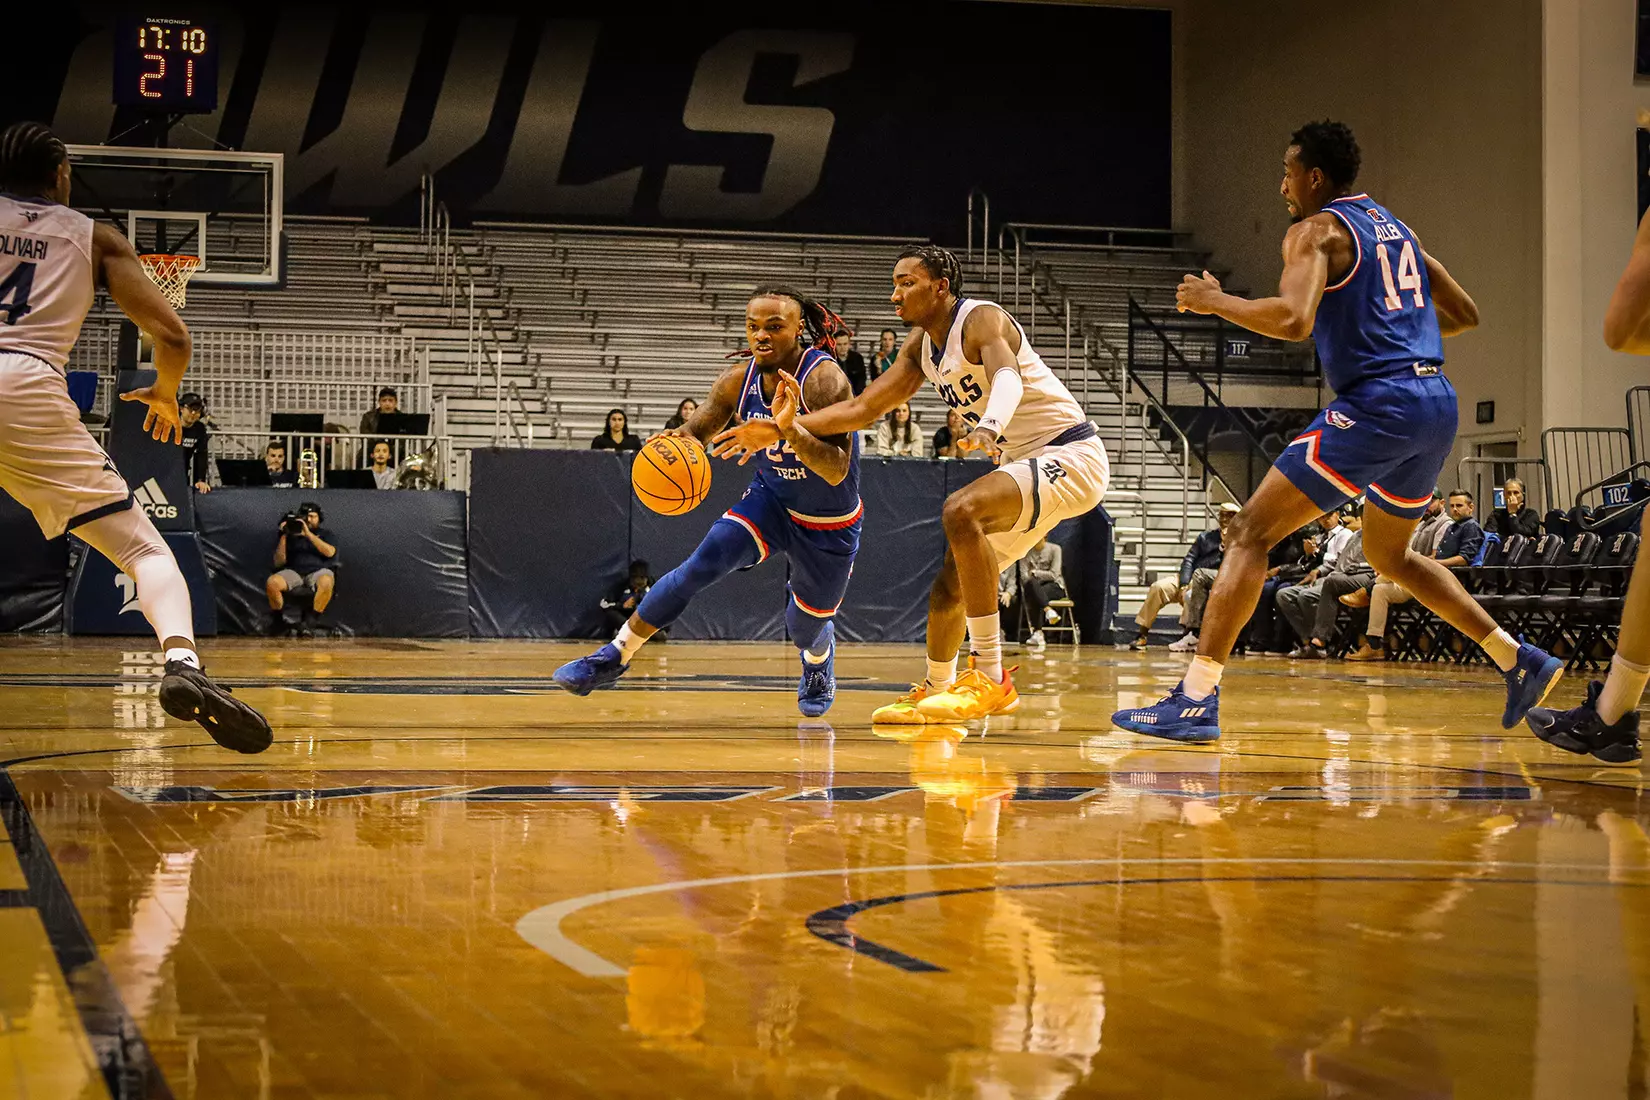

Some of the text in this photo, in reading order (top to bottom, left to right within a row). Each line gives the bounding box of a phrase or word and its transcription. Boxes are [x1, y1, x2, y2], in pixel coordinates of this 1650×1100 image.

[146, 17, 191, 25] DAKTRONICS
[139, 26, 206, 54] 17:10
[140, 54, 193, 98] 21
[1376, 240, 1425, 311] 14
[1232, 343, 1247, 355] 117
[772, 465, 808, 480] TECH
[1607, 486, 1630, 504] 102
